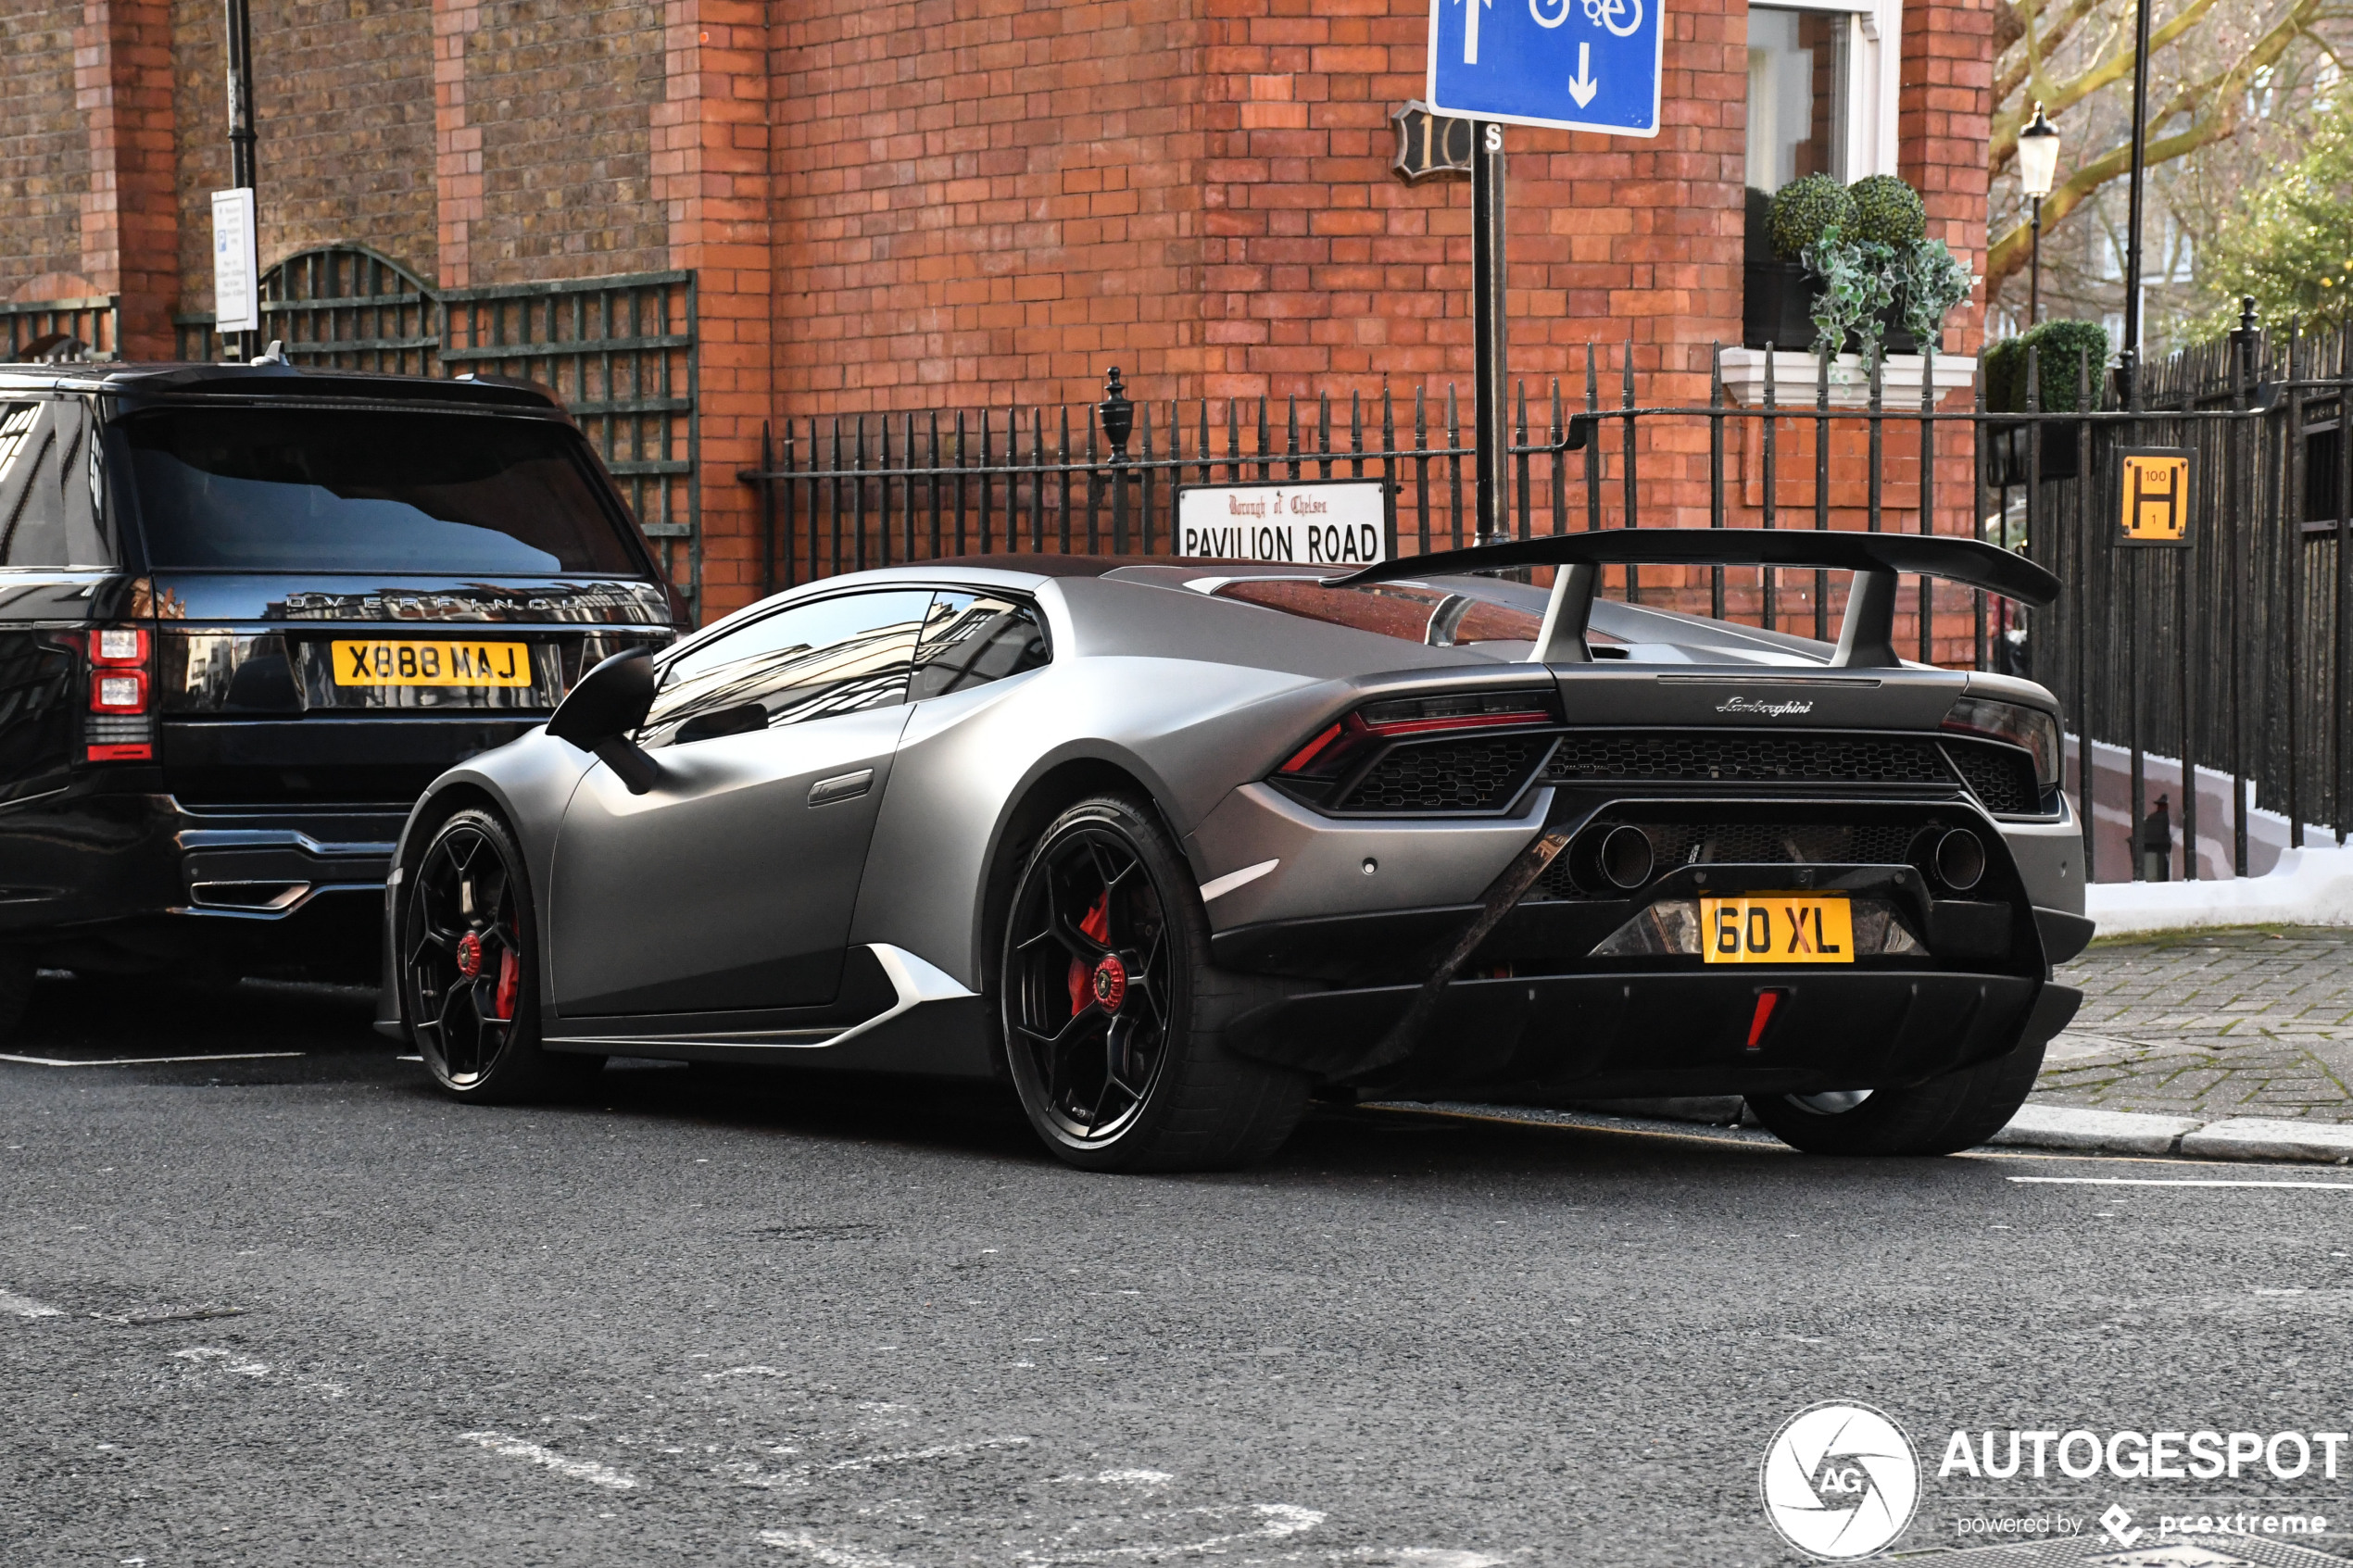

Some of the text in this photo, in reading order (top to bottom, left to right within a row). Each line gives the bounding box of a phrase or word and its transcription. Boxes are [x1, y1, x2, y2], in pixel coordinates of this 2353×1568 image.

[1485, 122, 1502, 151] S
[2145, 470, 2167, 482] 100
[1229, 494, 1327, 519] Borough of Chelsea
[2133, 466, 2178, 530] H
[2152, 514, 2157, 524] 1
[1186, 523, 1378, 563] PAVILION ROAD
[286, 596, 583, 611] OVERFINCH
[348, 646, 516, 679] X888 MAJ
[1715, 696, 1814, 718] Lamborghini
[1714, 907, 1841, 954] 60 XL
